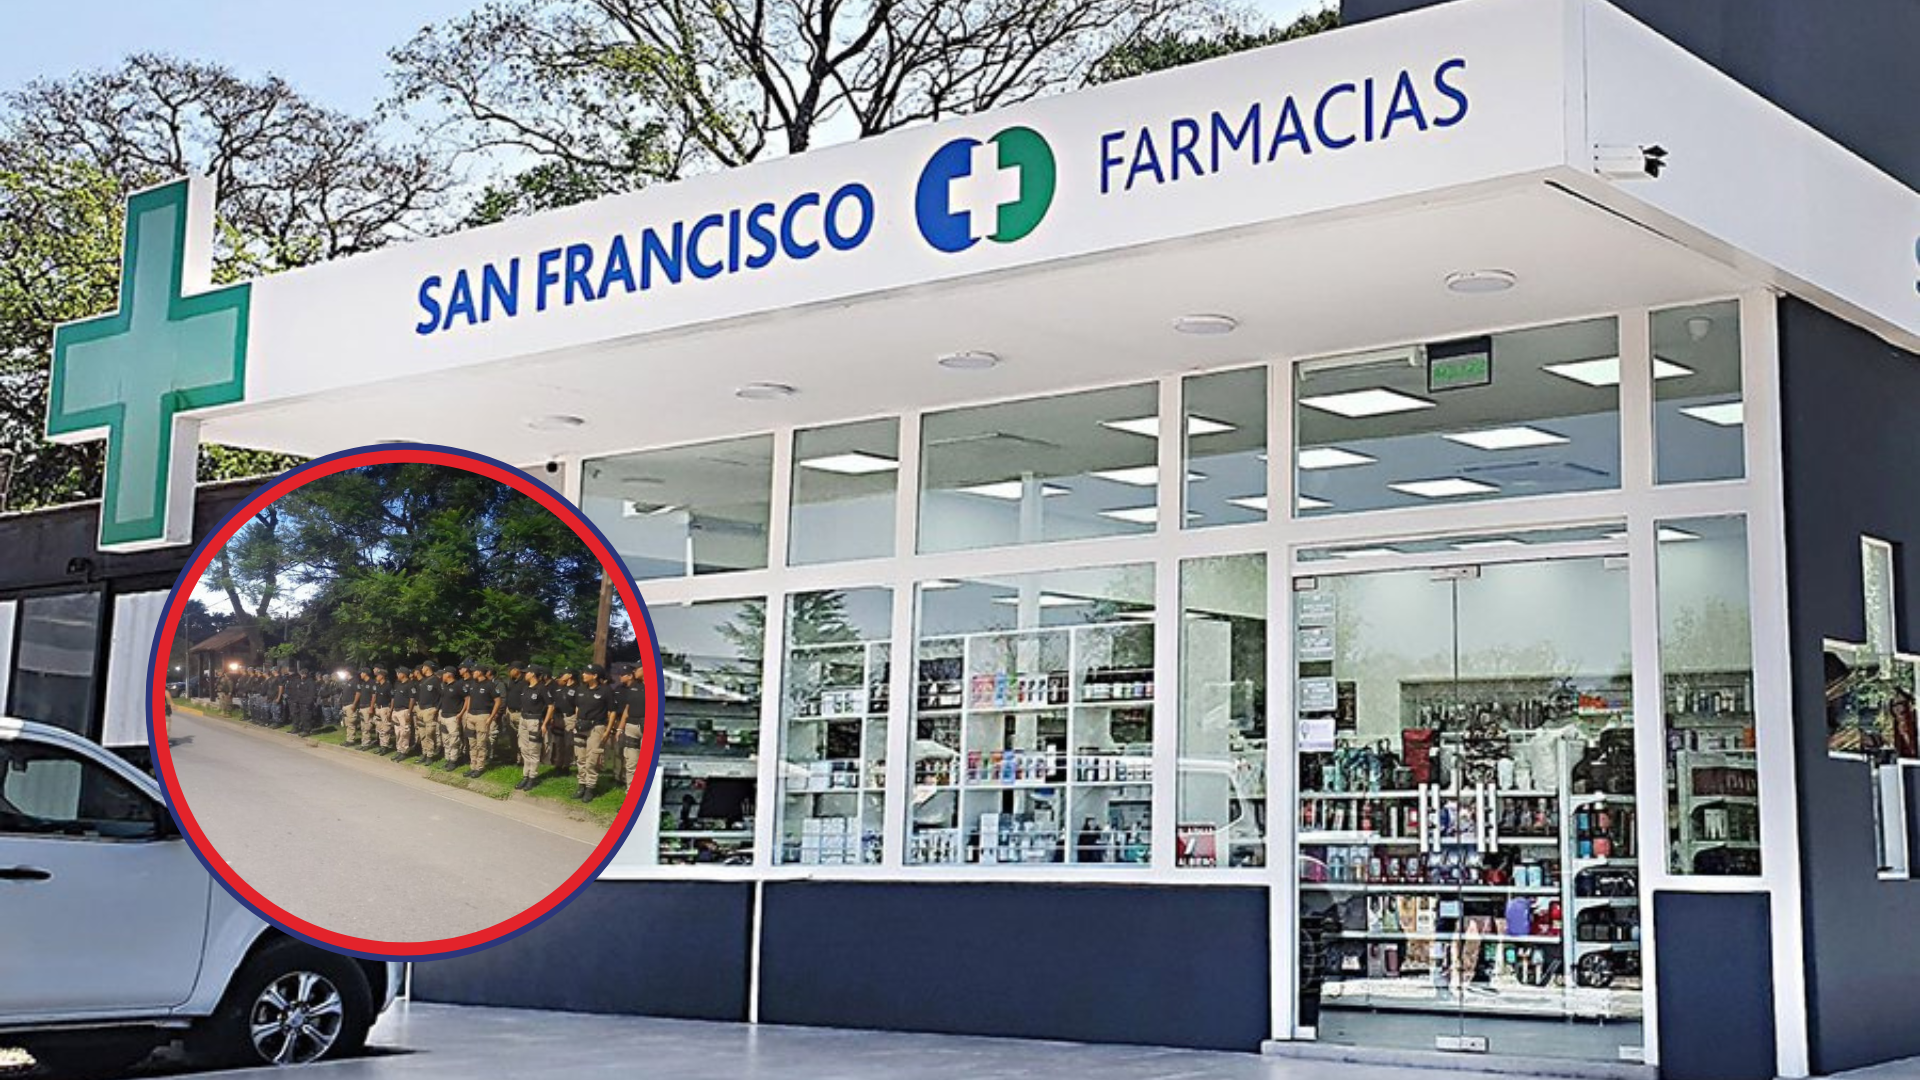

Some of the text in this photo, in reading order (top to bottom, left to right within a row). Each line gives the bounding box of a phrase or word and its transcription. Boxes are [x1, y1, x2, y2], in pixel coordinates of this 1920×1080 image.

[415, 58, 1469, 335] SAN FRANCISCO FARMACIAS
